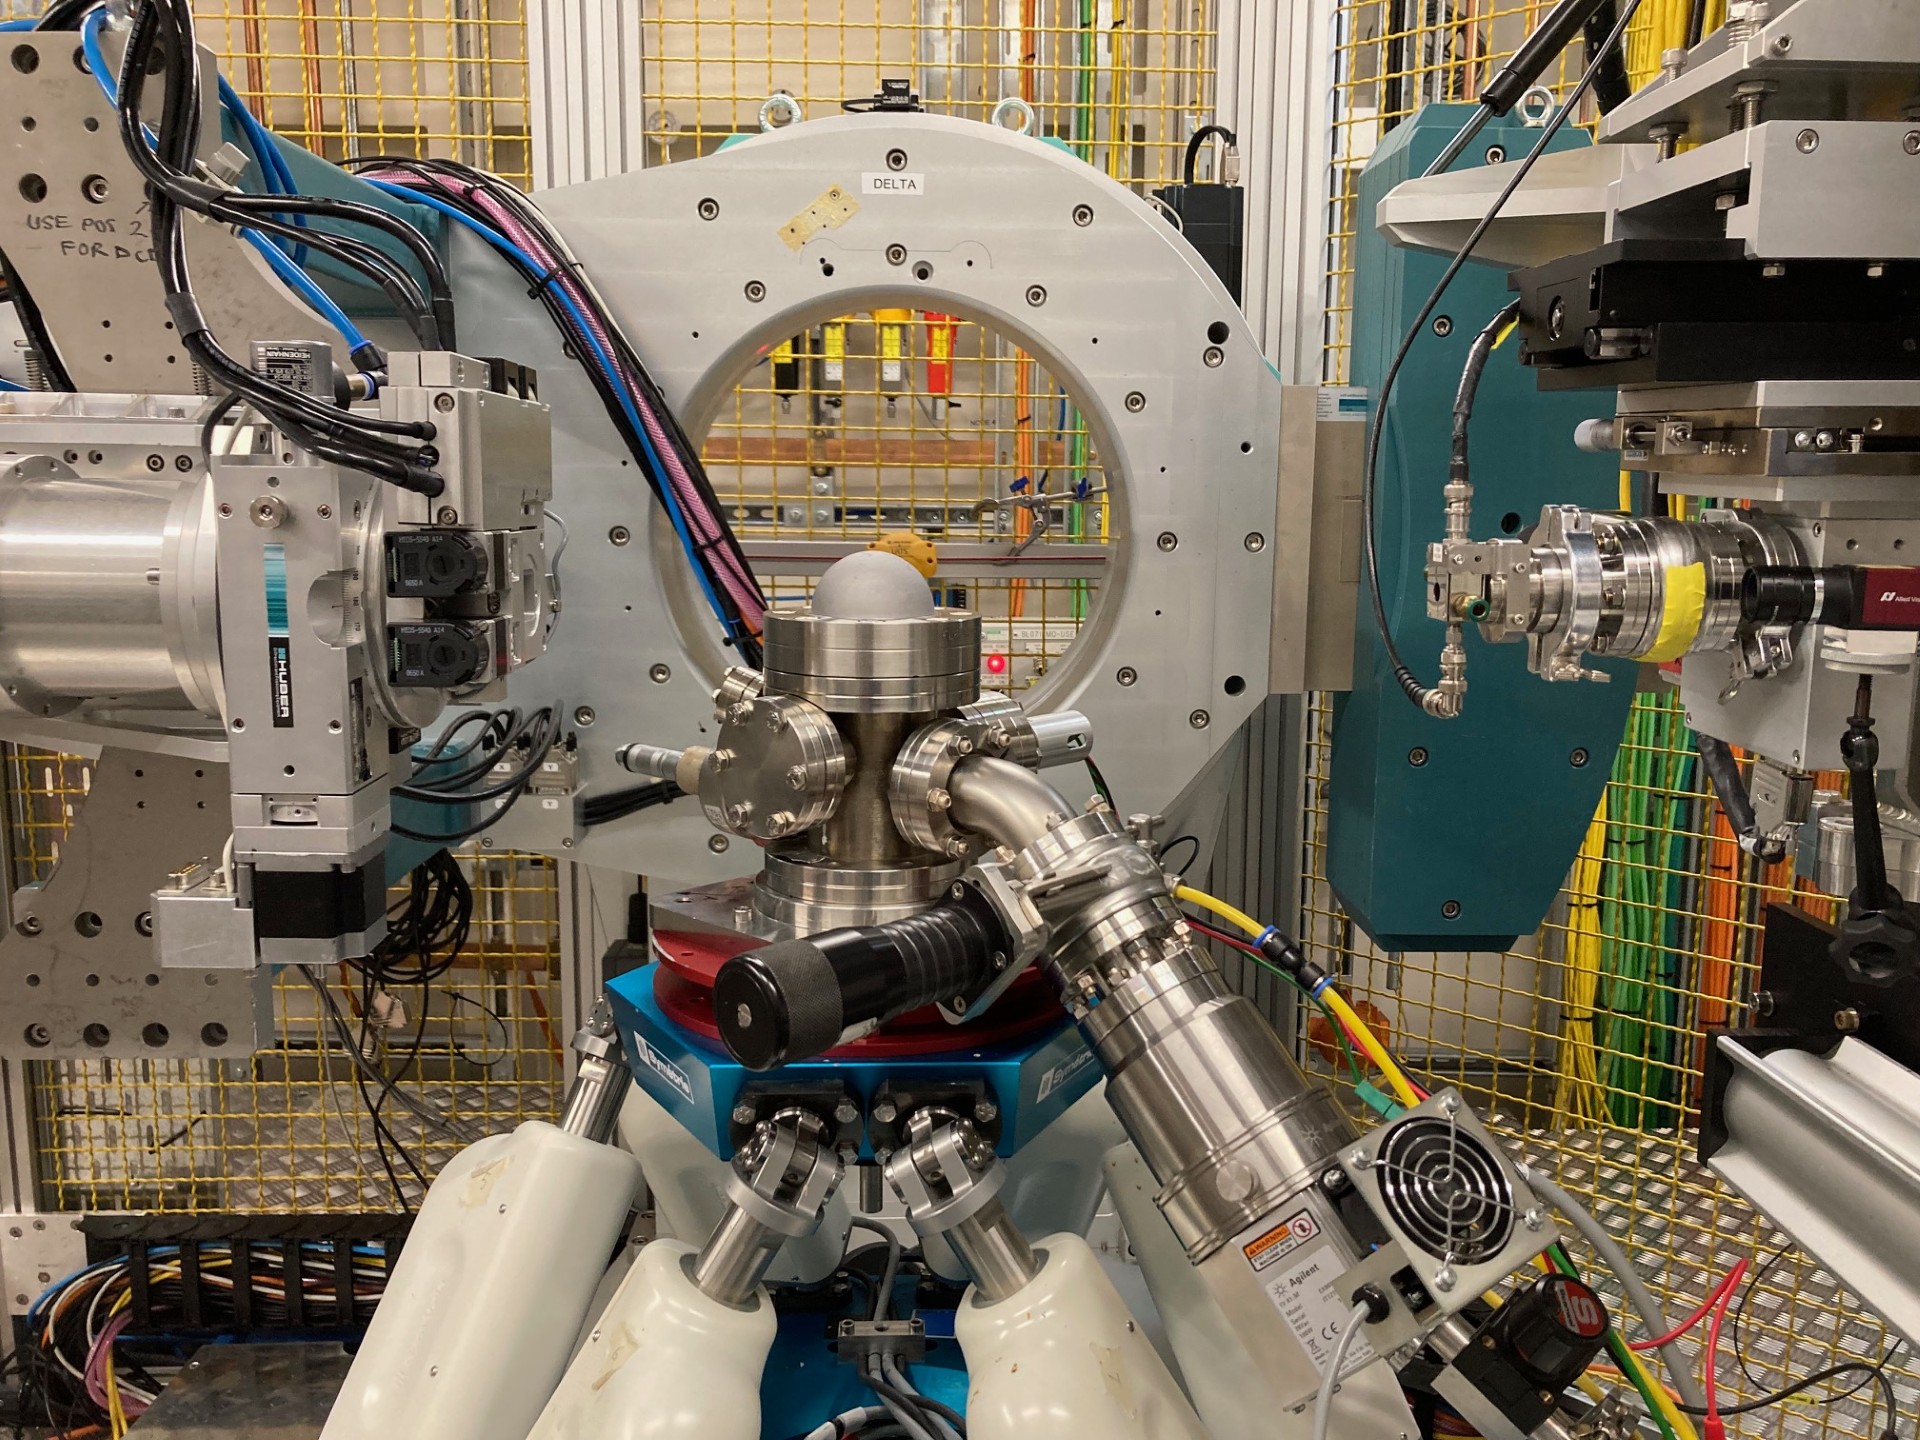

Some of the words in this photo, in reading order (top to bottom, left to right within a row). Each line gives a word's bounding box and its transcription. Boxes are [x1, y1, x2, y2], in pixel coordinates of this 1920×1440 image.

[873, 178, 917, 190] DELTA
[26, 213, 72, 230] USE
[81, 217, 117, 233] POS
[129, 220, 149, 238] 2
[60, 240, 109, 258] FOR
[266, 351, 311, 359] HEIDENHAIN
[278, 660, 290, 718] HUBER
[1254, 1228, 1288, 1251] WARNING
[1287, 1262, 1320, 1288] Agilent
